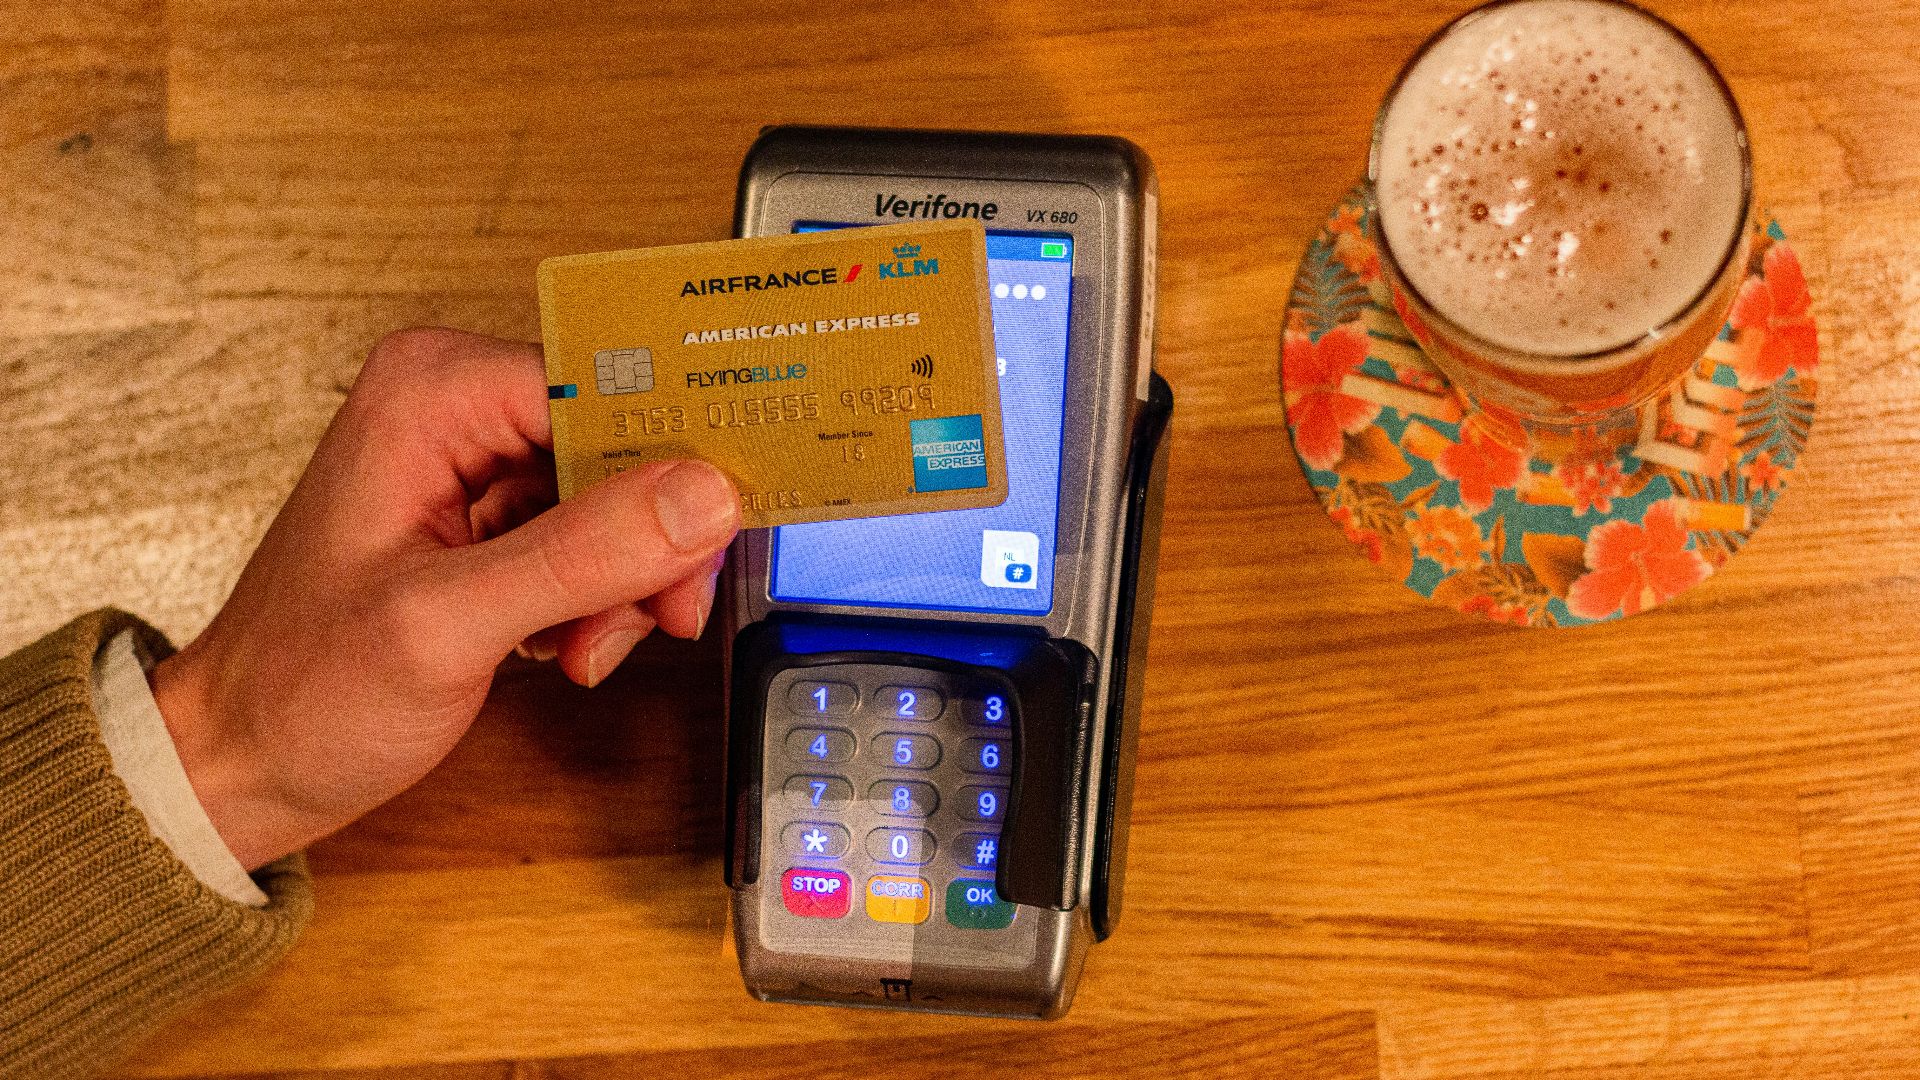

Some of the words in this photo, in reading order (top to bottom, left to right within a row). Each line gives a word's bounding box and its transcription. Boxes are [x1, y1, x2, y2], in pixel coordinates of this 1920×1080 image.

[875, 193, 998, 221] Verifone
[1026, 209, 1047, 223] VX
[1050, 210, 1078, 224] 680
[878, 257, 940, 280] KLM
[680, 267, 838, 298] AIRFRANCE
[683, 321, 808, 345] AMERICAN
[814, 311, 921, 334] EXPRESS
[612, 405, 688, 437] 3753
[706, 391, 820, 429] 015555
[840, 383, 936, 416] 99209
[817, 431, 849, 441] Member
[851, 429, 874, 439] Since
[602, 450, 622, 459] Valid
[624, 449, 641, 458] Thru
[913, 438, 981, 457] AMERICAN
[927, 453, 986, 470] EXPRESS
[1003, 552, 1016, 562] NL
[1012, 567, 1024, 580] #
[813, 687, 827, 713] 1
[898, 692, 916, 717] 2
[985, 697, 1004, 722] 3
[809, 734, 828, 759] 4
[895, 739, 913, 765] 5
[981, 744, 999, 769] 6
[810, 781, 828, 806] 7
[893, 787, 911, 811] 8
[978, 792, 996, 817] 9
[891, 835, 909, 860] 0
[976, 839, 996, 865] #
[792, 876, 841, 895] STOP
[871, 880, 924, 898] CORR
[966, 887, 993, 904] OK
